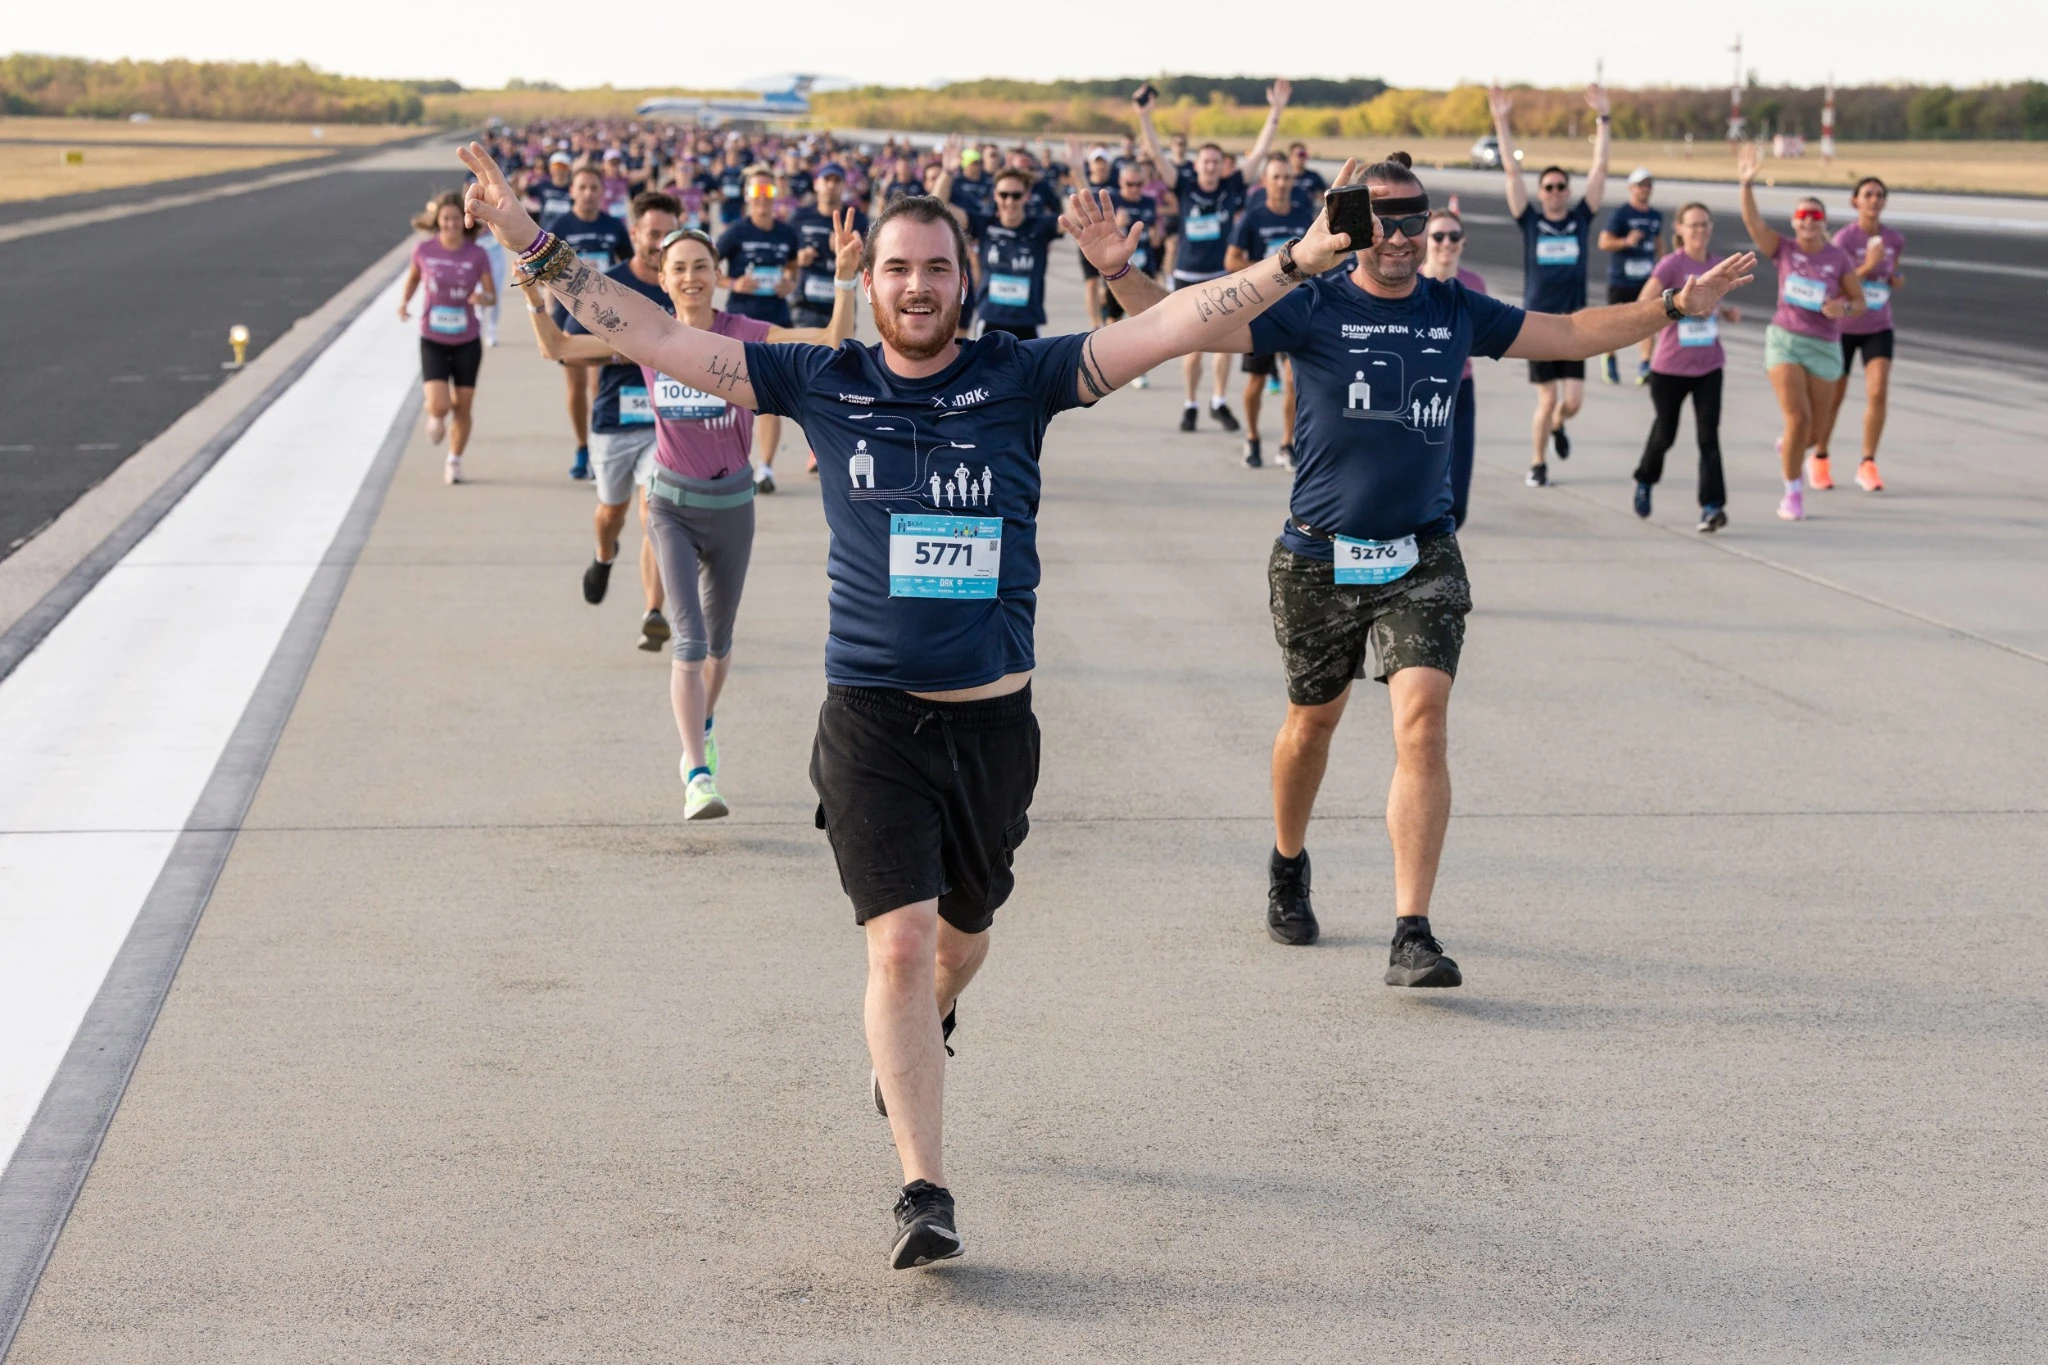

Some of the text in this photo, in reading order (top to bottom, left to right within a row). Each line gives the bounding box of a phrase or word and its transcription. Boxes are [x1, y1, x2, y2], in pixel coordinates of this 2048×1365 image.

[1341, 324, 1387, 333] RUNWAY
[1388, 325, 1409, 334] RUN
[848, 393, 875, 403] BUDAPEST
[914, 541, 973, 567] 5771
[1350, 545, 1398, 560] 5276
